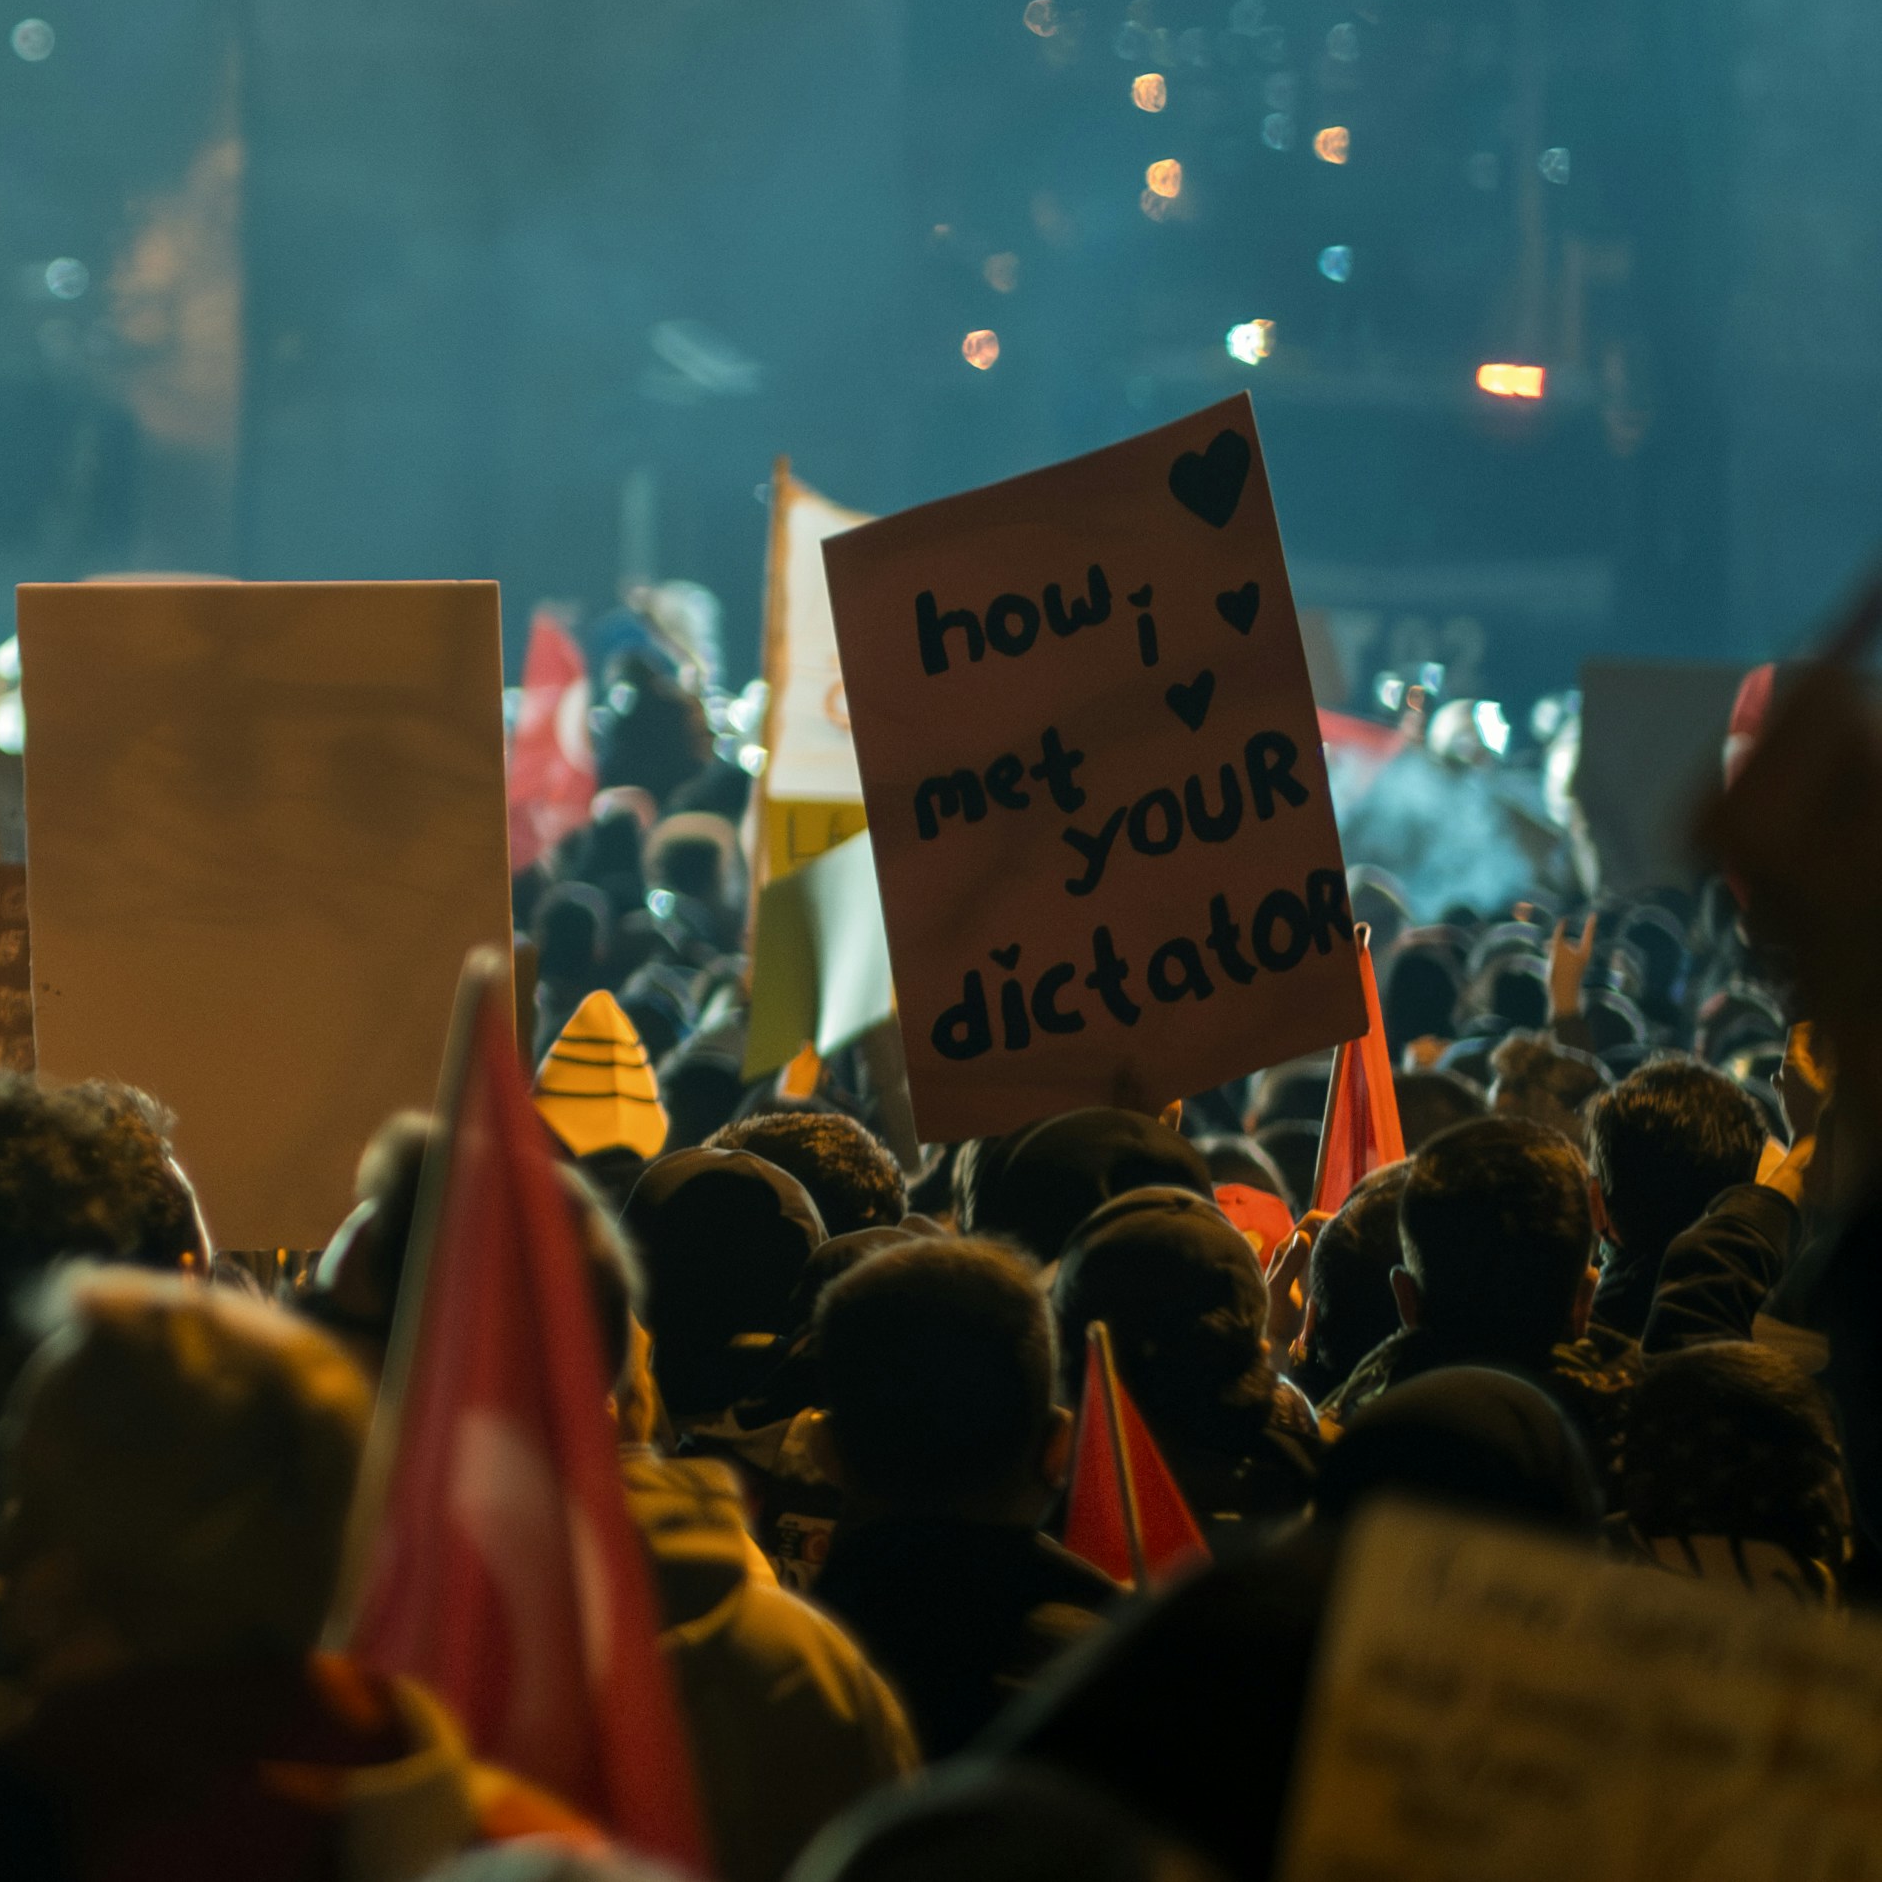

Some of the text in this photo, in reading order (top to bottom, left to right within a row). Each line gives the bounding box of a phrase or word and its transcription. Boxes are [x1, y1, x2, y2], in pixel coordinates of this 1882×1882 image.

[914, 564, 1159, 676] how i
[913, 725, 1087, 841] met
